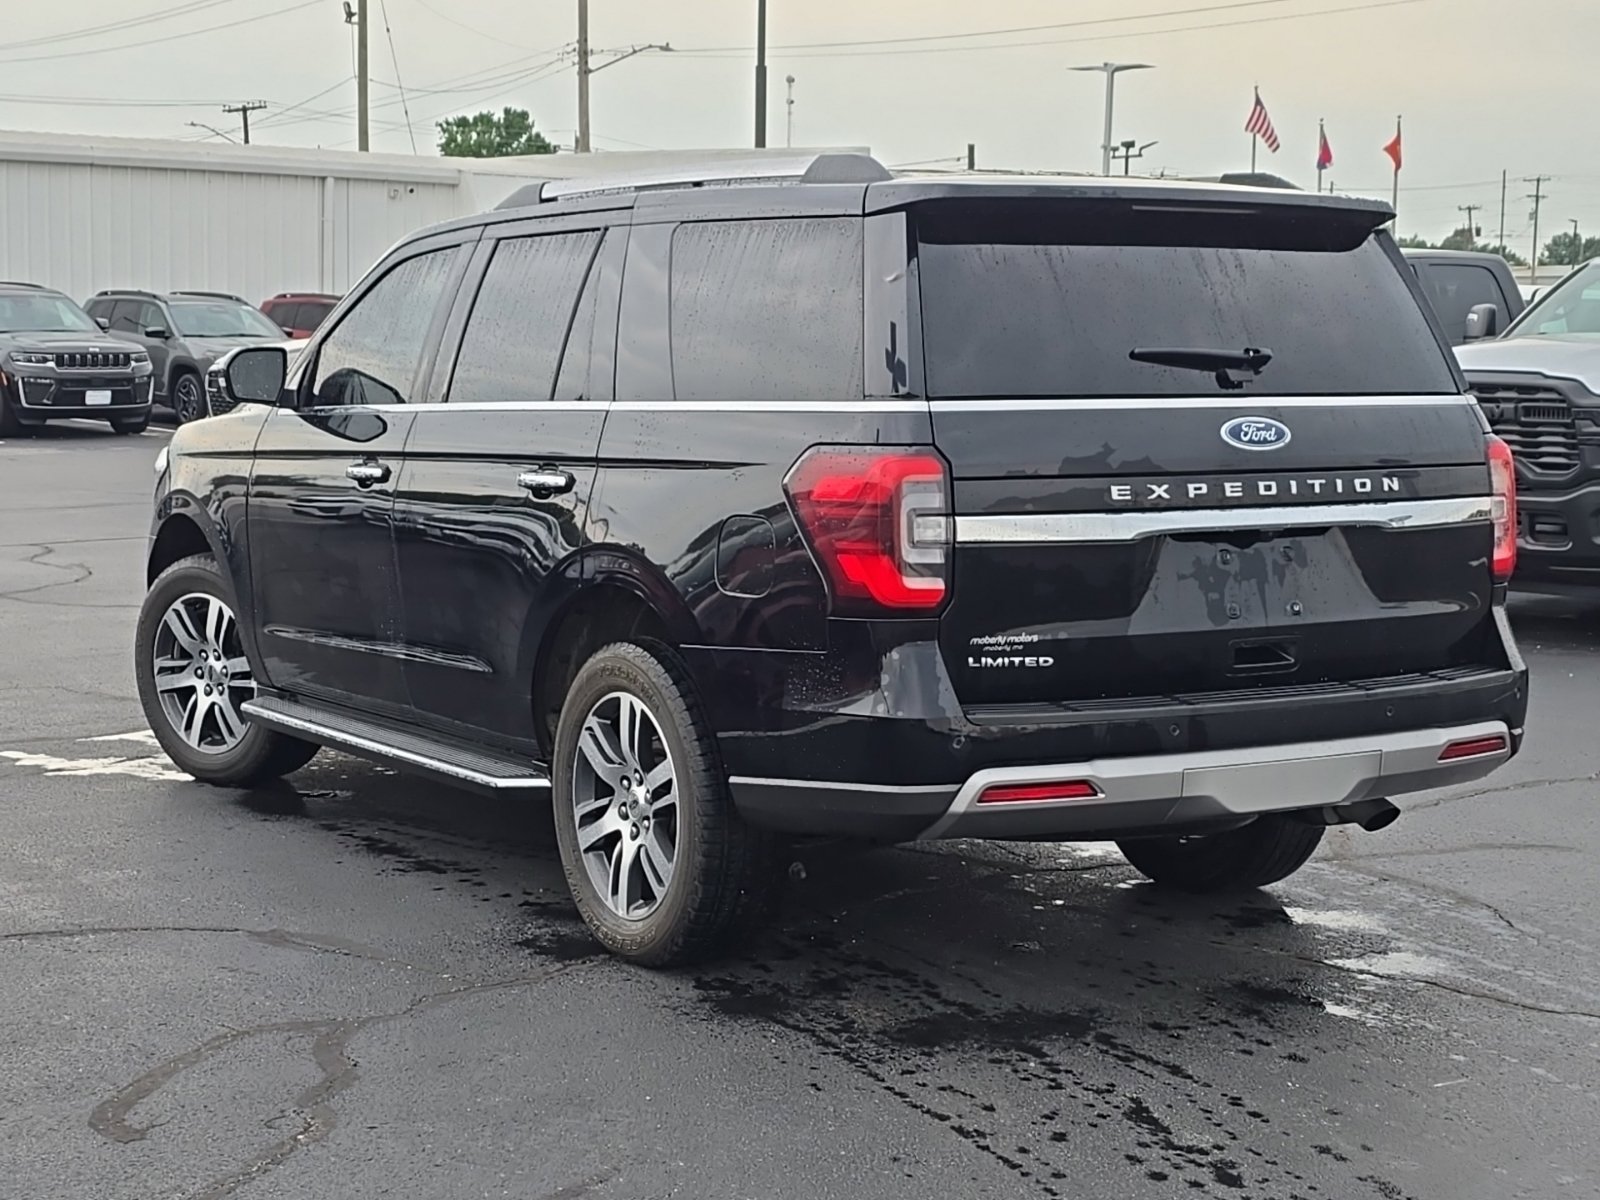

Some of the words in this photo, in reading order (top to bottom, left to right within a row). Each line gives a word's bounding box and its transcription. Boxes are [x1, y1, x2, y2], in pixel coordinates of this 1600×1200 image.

[1240, 422, 1277, 442] Ford
[1110, 476, 1400, 501] EXPEDITION
[970, 635, 1006, 645] moberly
[1007, 632, 1039, 643] motors
[967, 656, 1054, 667] LIMITED
